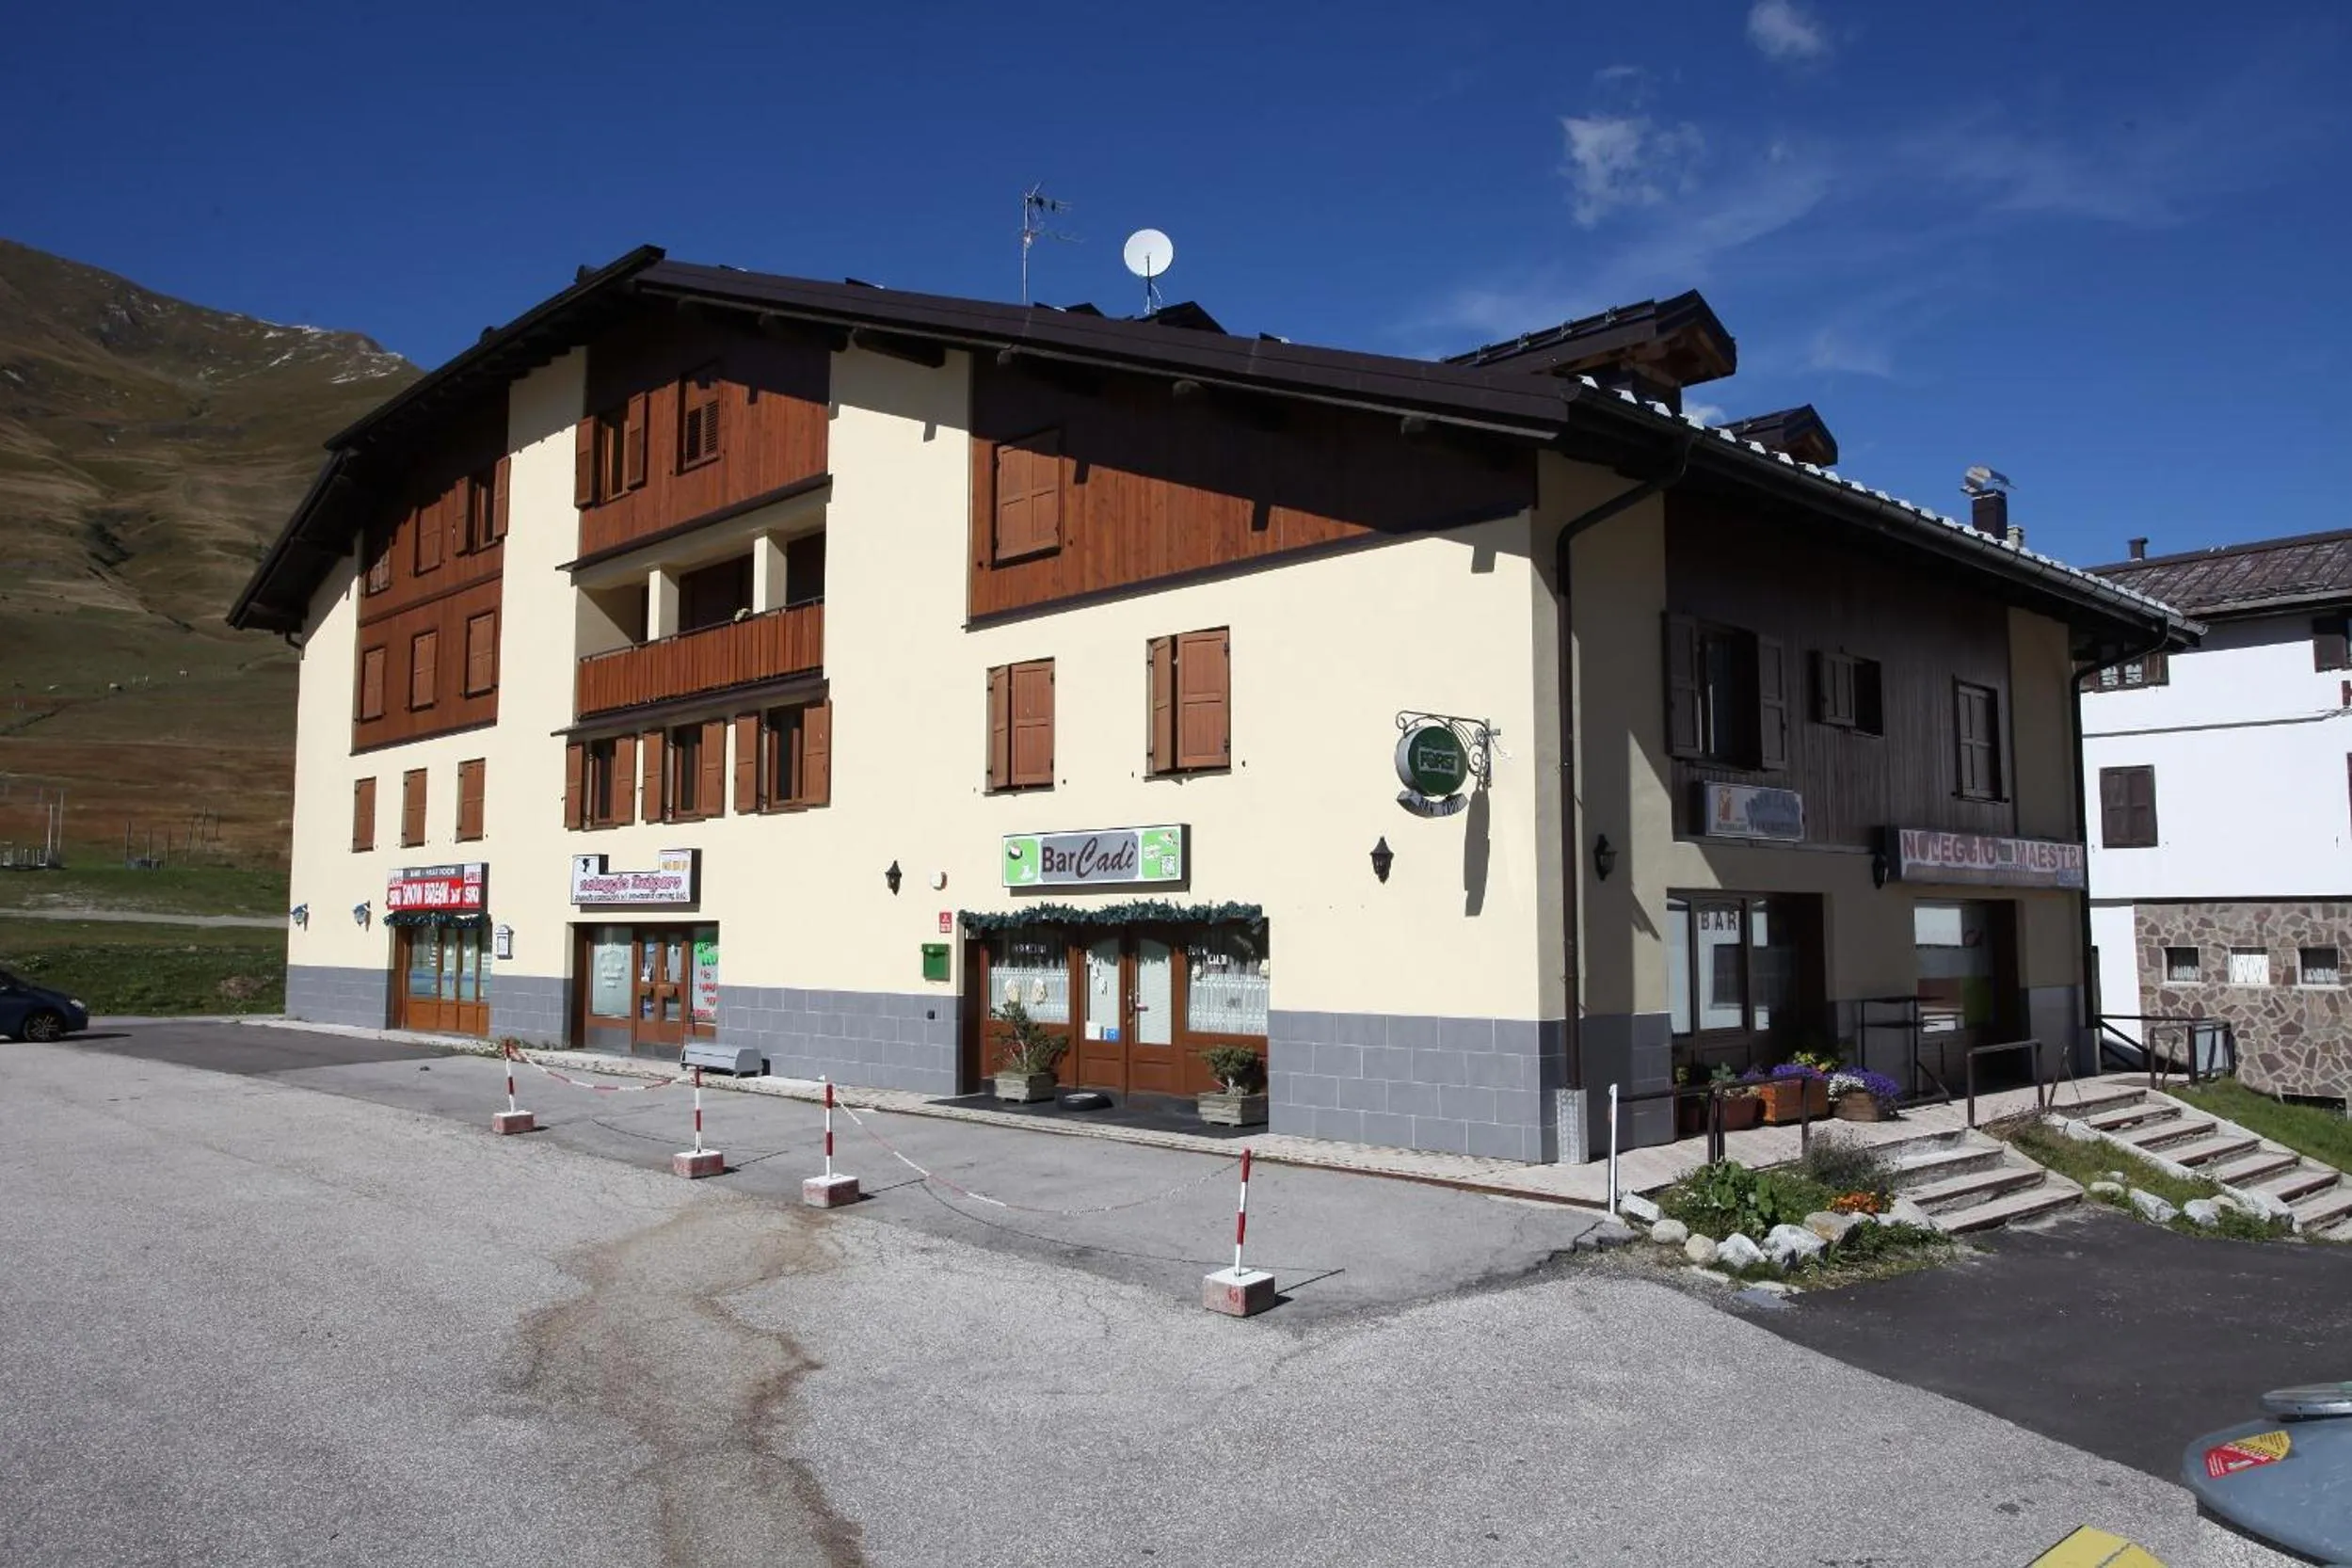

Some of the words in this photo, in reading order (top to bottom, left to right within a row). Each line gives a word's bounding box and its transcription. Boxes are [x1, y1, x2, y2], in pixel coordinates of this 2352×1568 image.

[1042, 846, 1076, 872] Bar
[1075, 837, 1136, 878] Cadì
[1902, 832, 1998, 864] NOLEGGIO
[2014, 840, 2083, 870] MAESTRI
[1701, 910, 1736, 931] BAR
